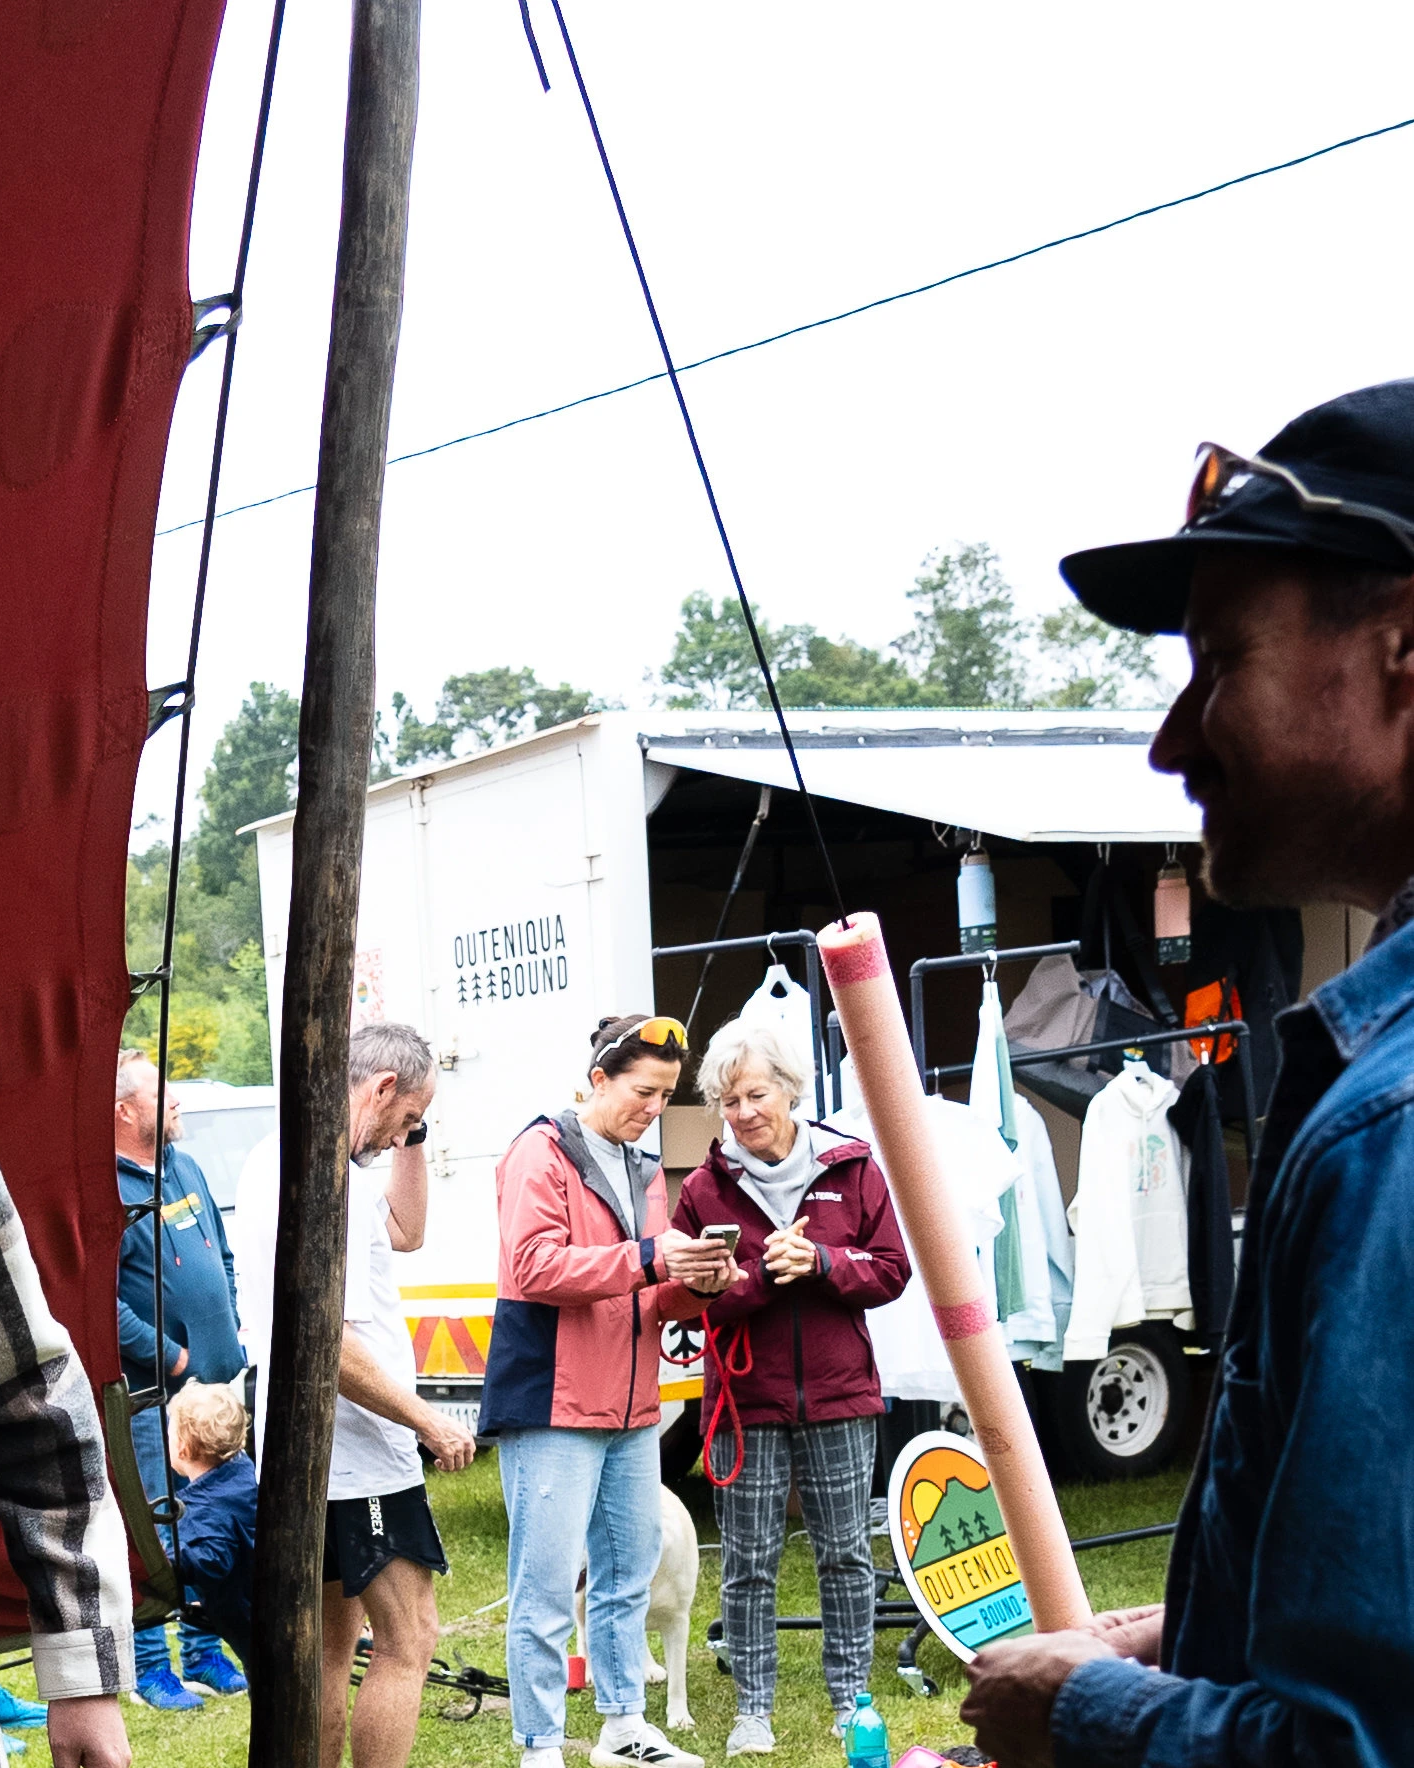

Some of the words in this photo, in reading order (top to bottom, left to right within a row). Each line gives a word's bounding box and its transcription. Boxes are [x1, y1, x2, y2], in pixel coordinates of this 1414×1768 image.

[455, 914, 565, 968] OUTENIQUA
[500, 955, 567, 999] BOUND
[368, 1496, 384, 1536] ERREX
[924, 1542, 1018, 1606] OUTENIQ
[978, 1594, 1022, 1630] BOUND
